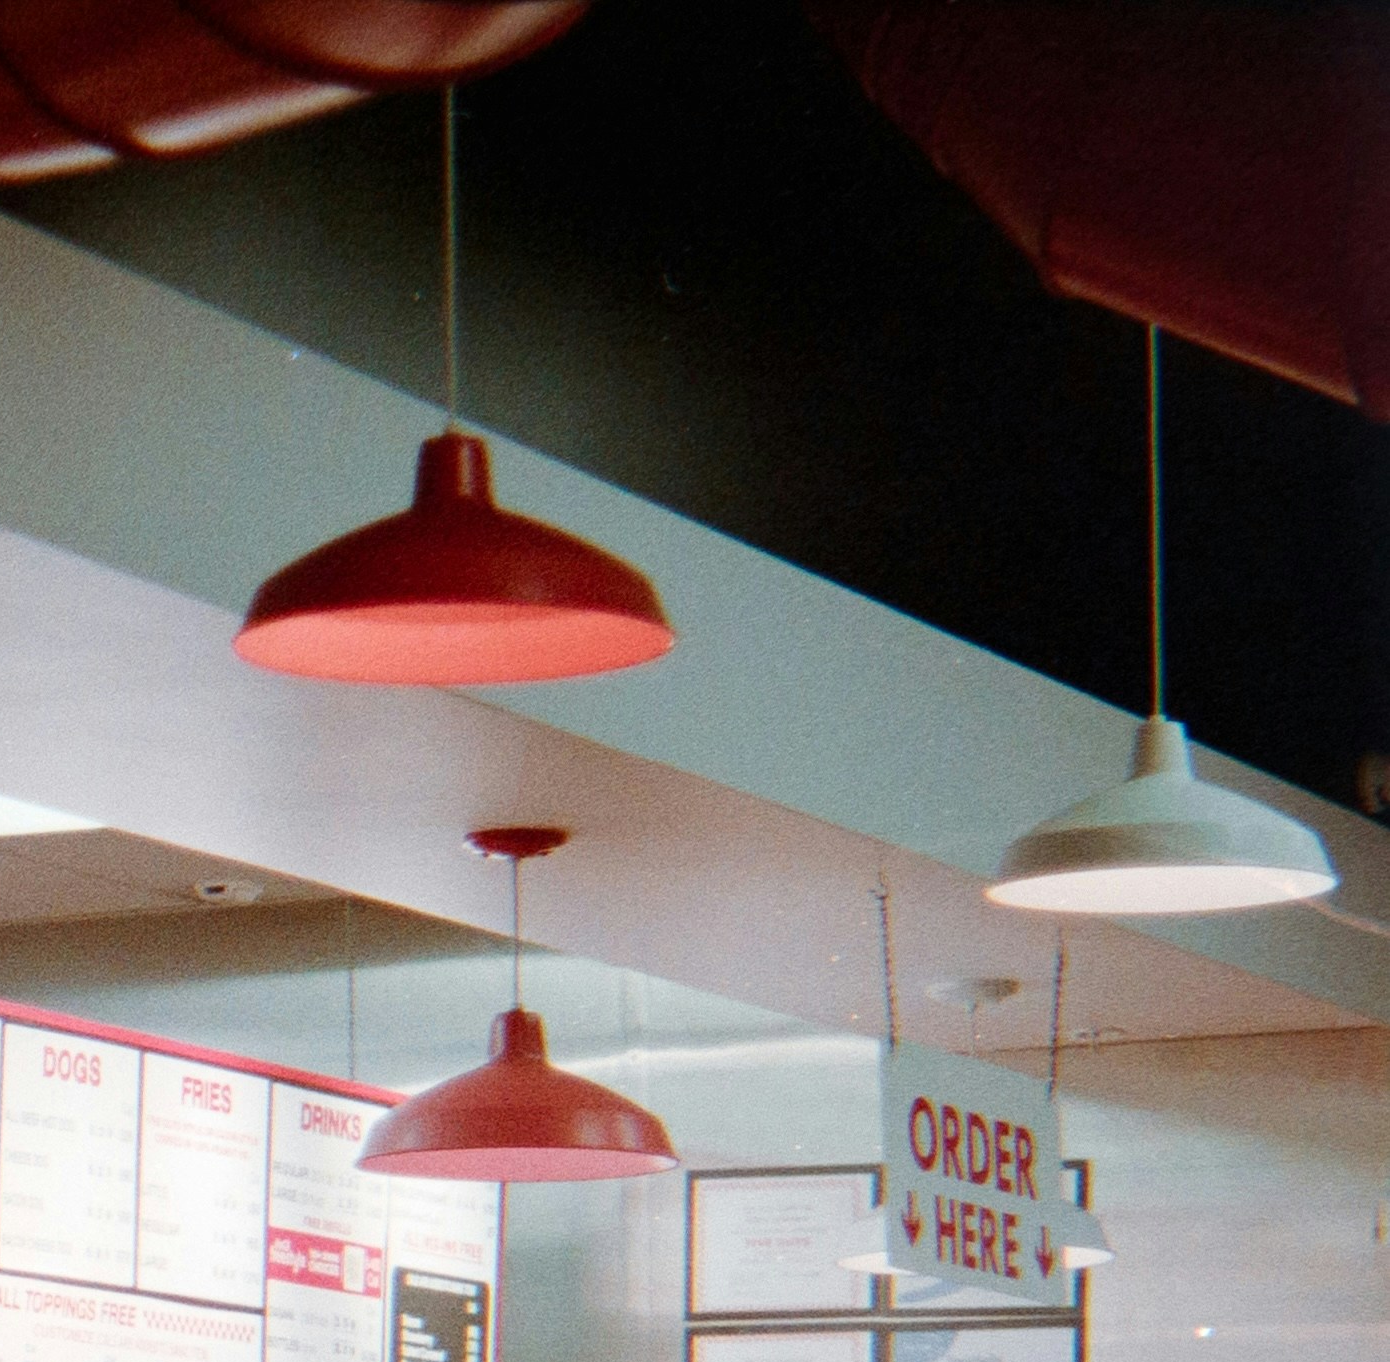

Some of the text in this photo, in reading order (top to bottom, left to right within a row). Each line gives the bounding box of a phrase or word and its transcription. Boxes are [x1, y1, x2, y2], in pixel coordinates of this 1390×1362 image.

[43, 1046, 102, 1087] DOGS
[181, 1076, 233, 1115] FRIES
[300, 1102, 361, 1142] DRINKS
[908, 1095, 1037, 1200] ORDER
[934, 1194, 1021, 1280] HERE
[26, 1290, 96, 1322] TOPPINGS
[100, 1302, 137, 1328] FREE
